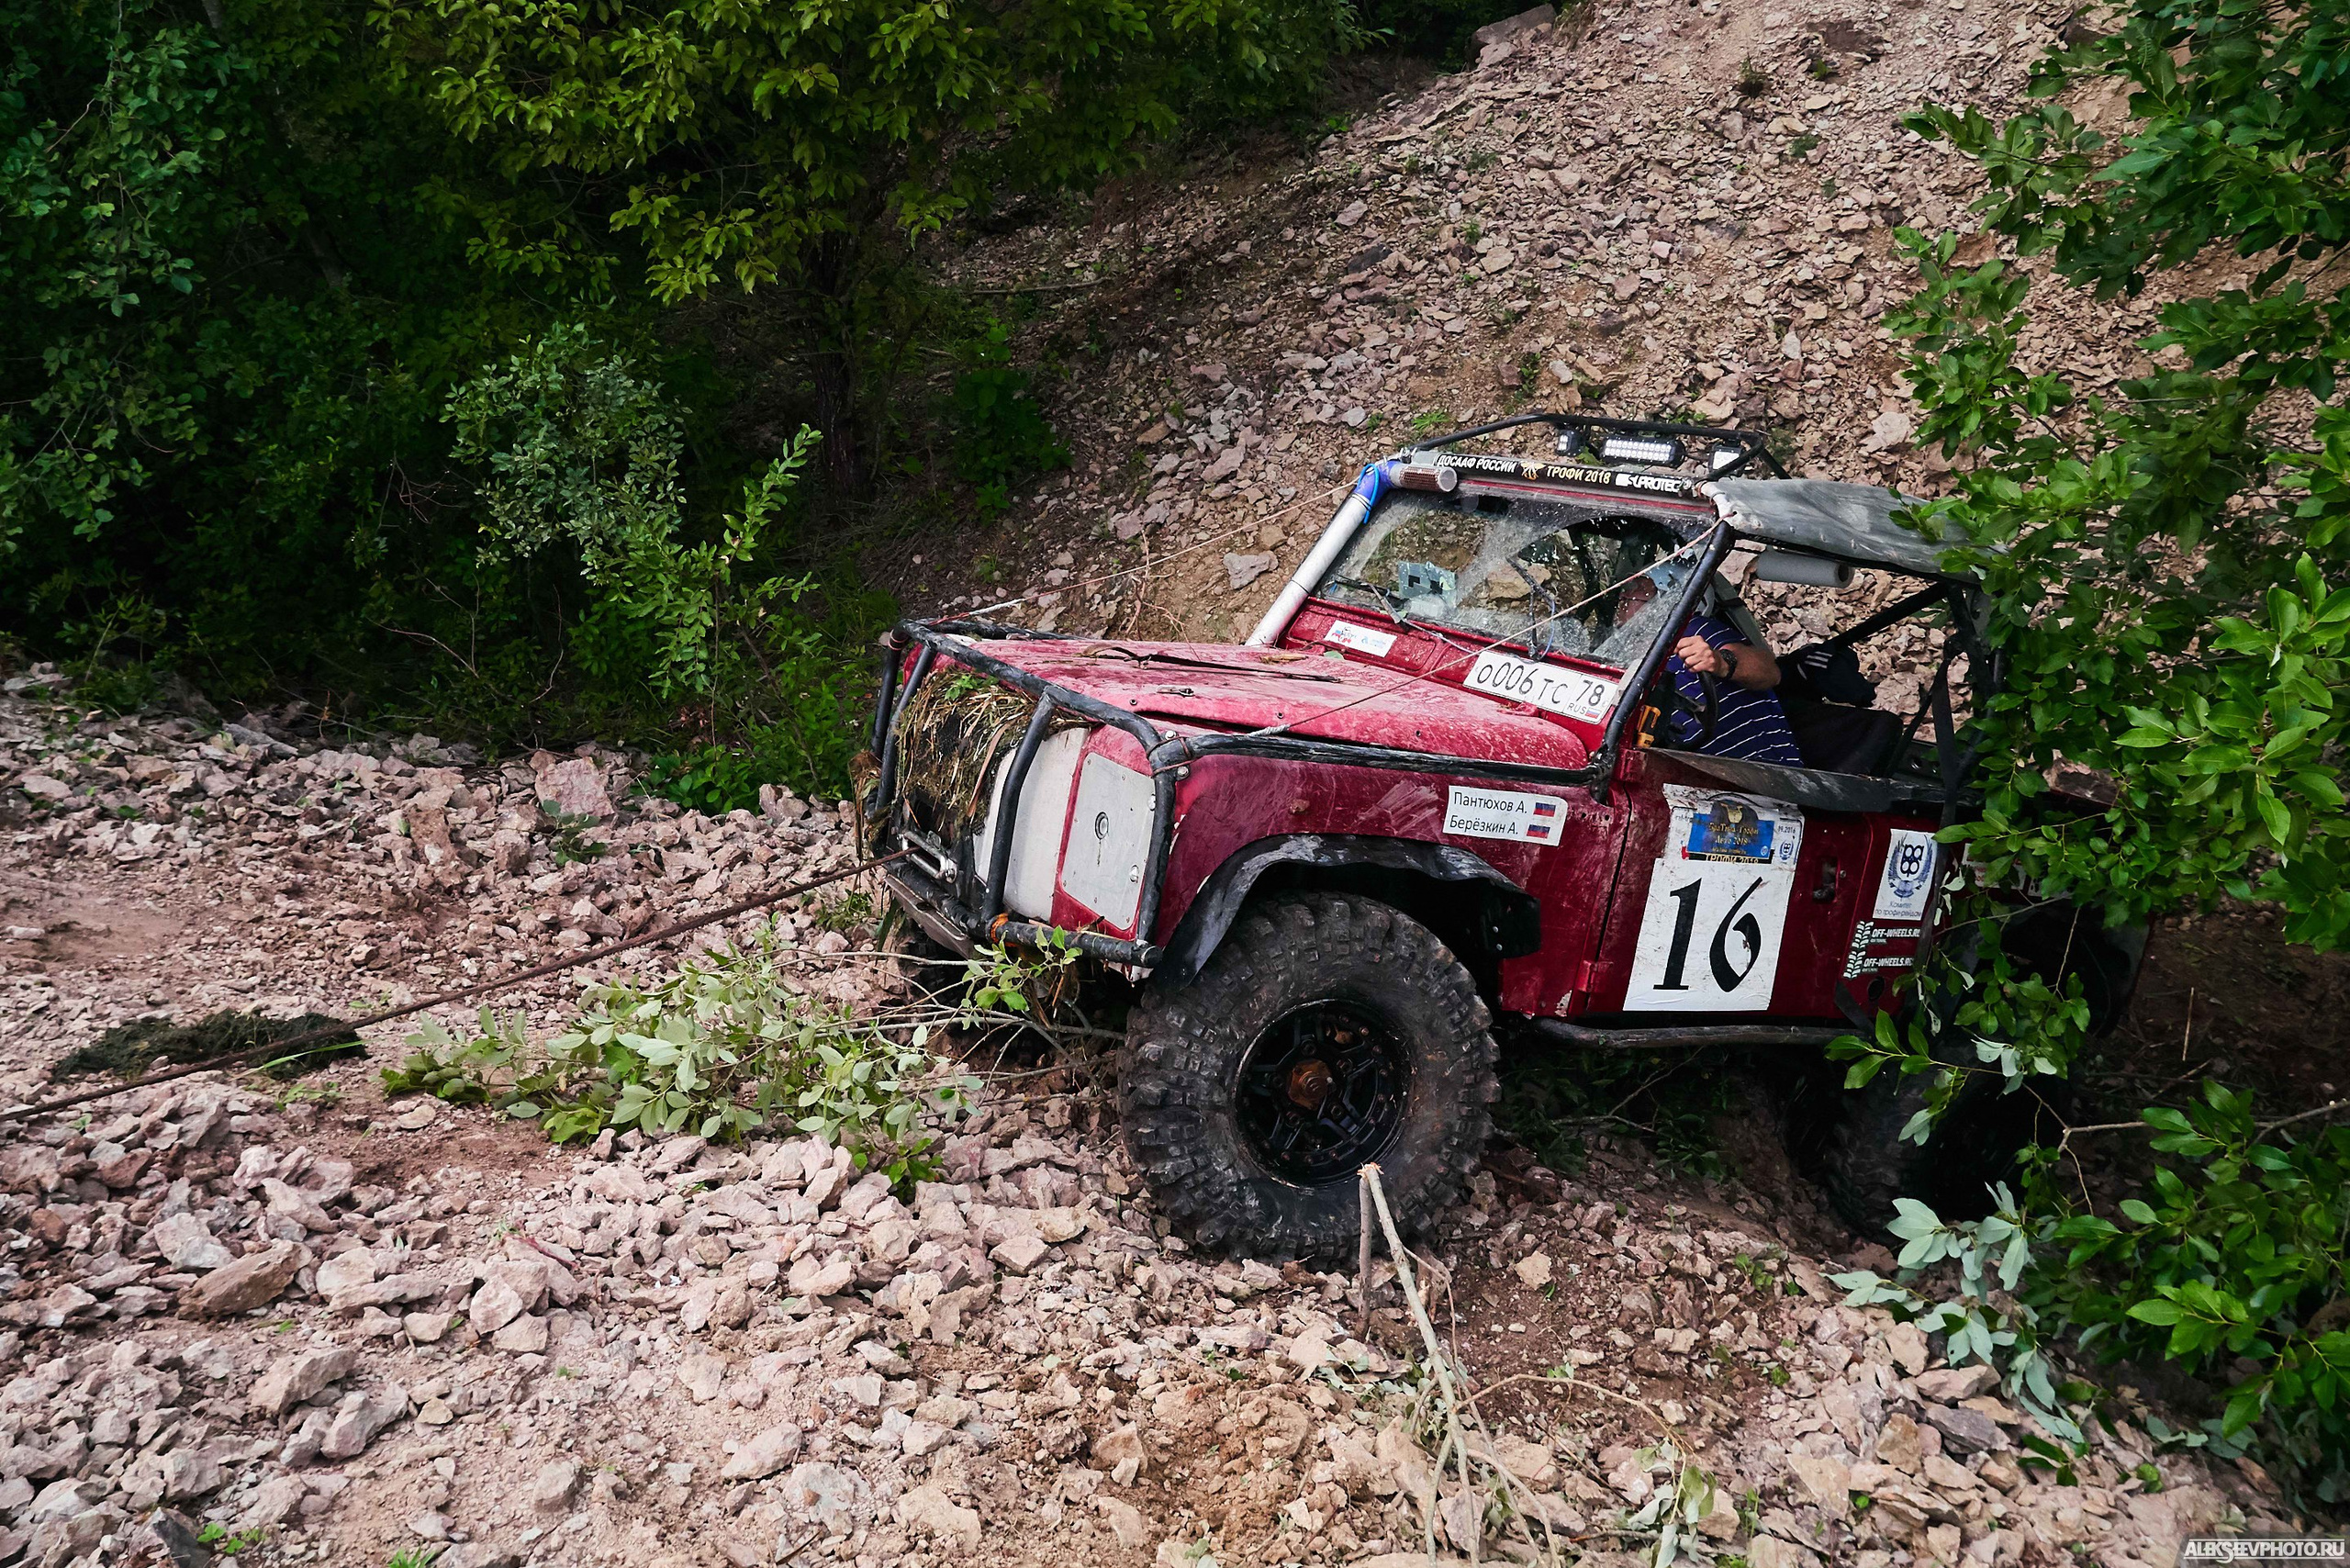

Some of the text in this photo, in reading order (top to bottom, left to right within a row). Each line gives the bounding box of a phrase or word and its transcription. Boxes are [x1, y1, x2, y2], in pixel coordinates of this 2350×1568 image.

[1437, 454, 1517, 474] ДОСААФ РОССИИ
[1546, 465, 1612, 485] ТРОФИ 2018
[1576, 679, 1605, 707] 78
[1567, 703, 1586, 715] RUS
[1454, 791, 1528, 814] Пантюхов А.
[1449, 814, 1518, 835] Берёзкин А.
[1653, 876, 1763, 993] 16
